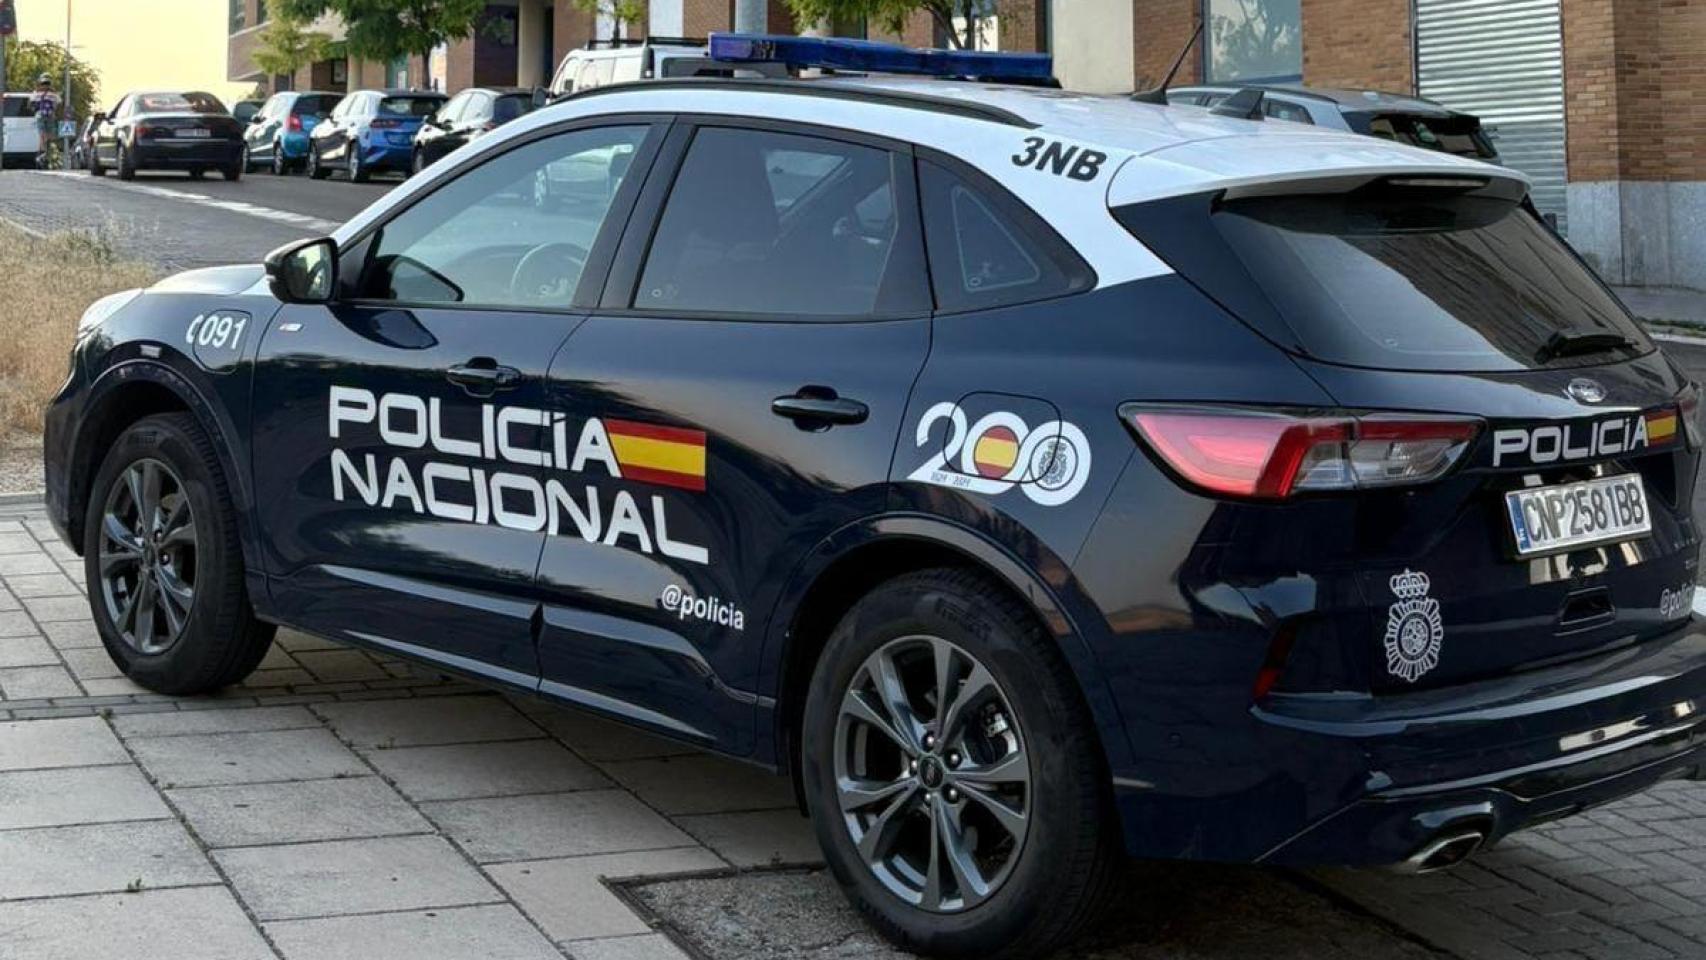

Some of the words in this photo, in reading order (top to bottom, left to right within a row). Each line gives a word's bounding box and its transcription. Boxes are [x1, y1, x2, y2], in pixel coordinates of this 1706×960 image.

[1011, 136, 1107, 182] 3NB
[198, 314, 247, 349] 091
[906, 401, 1092, 507] 200
[331, 448, 709, 565] NACIONAL
[1522, 482, 1645, 542] CNP2581BB
[661, 584, 745, 631] @policia
